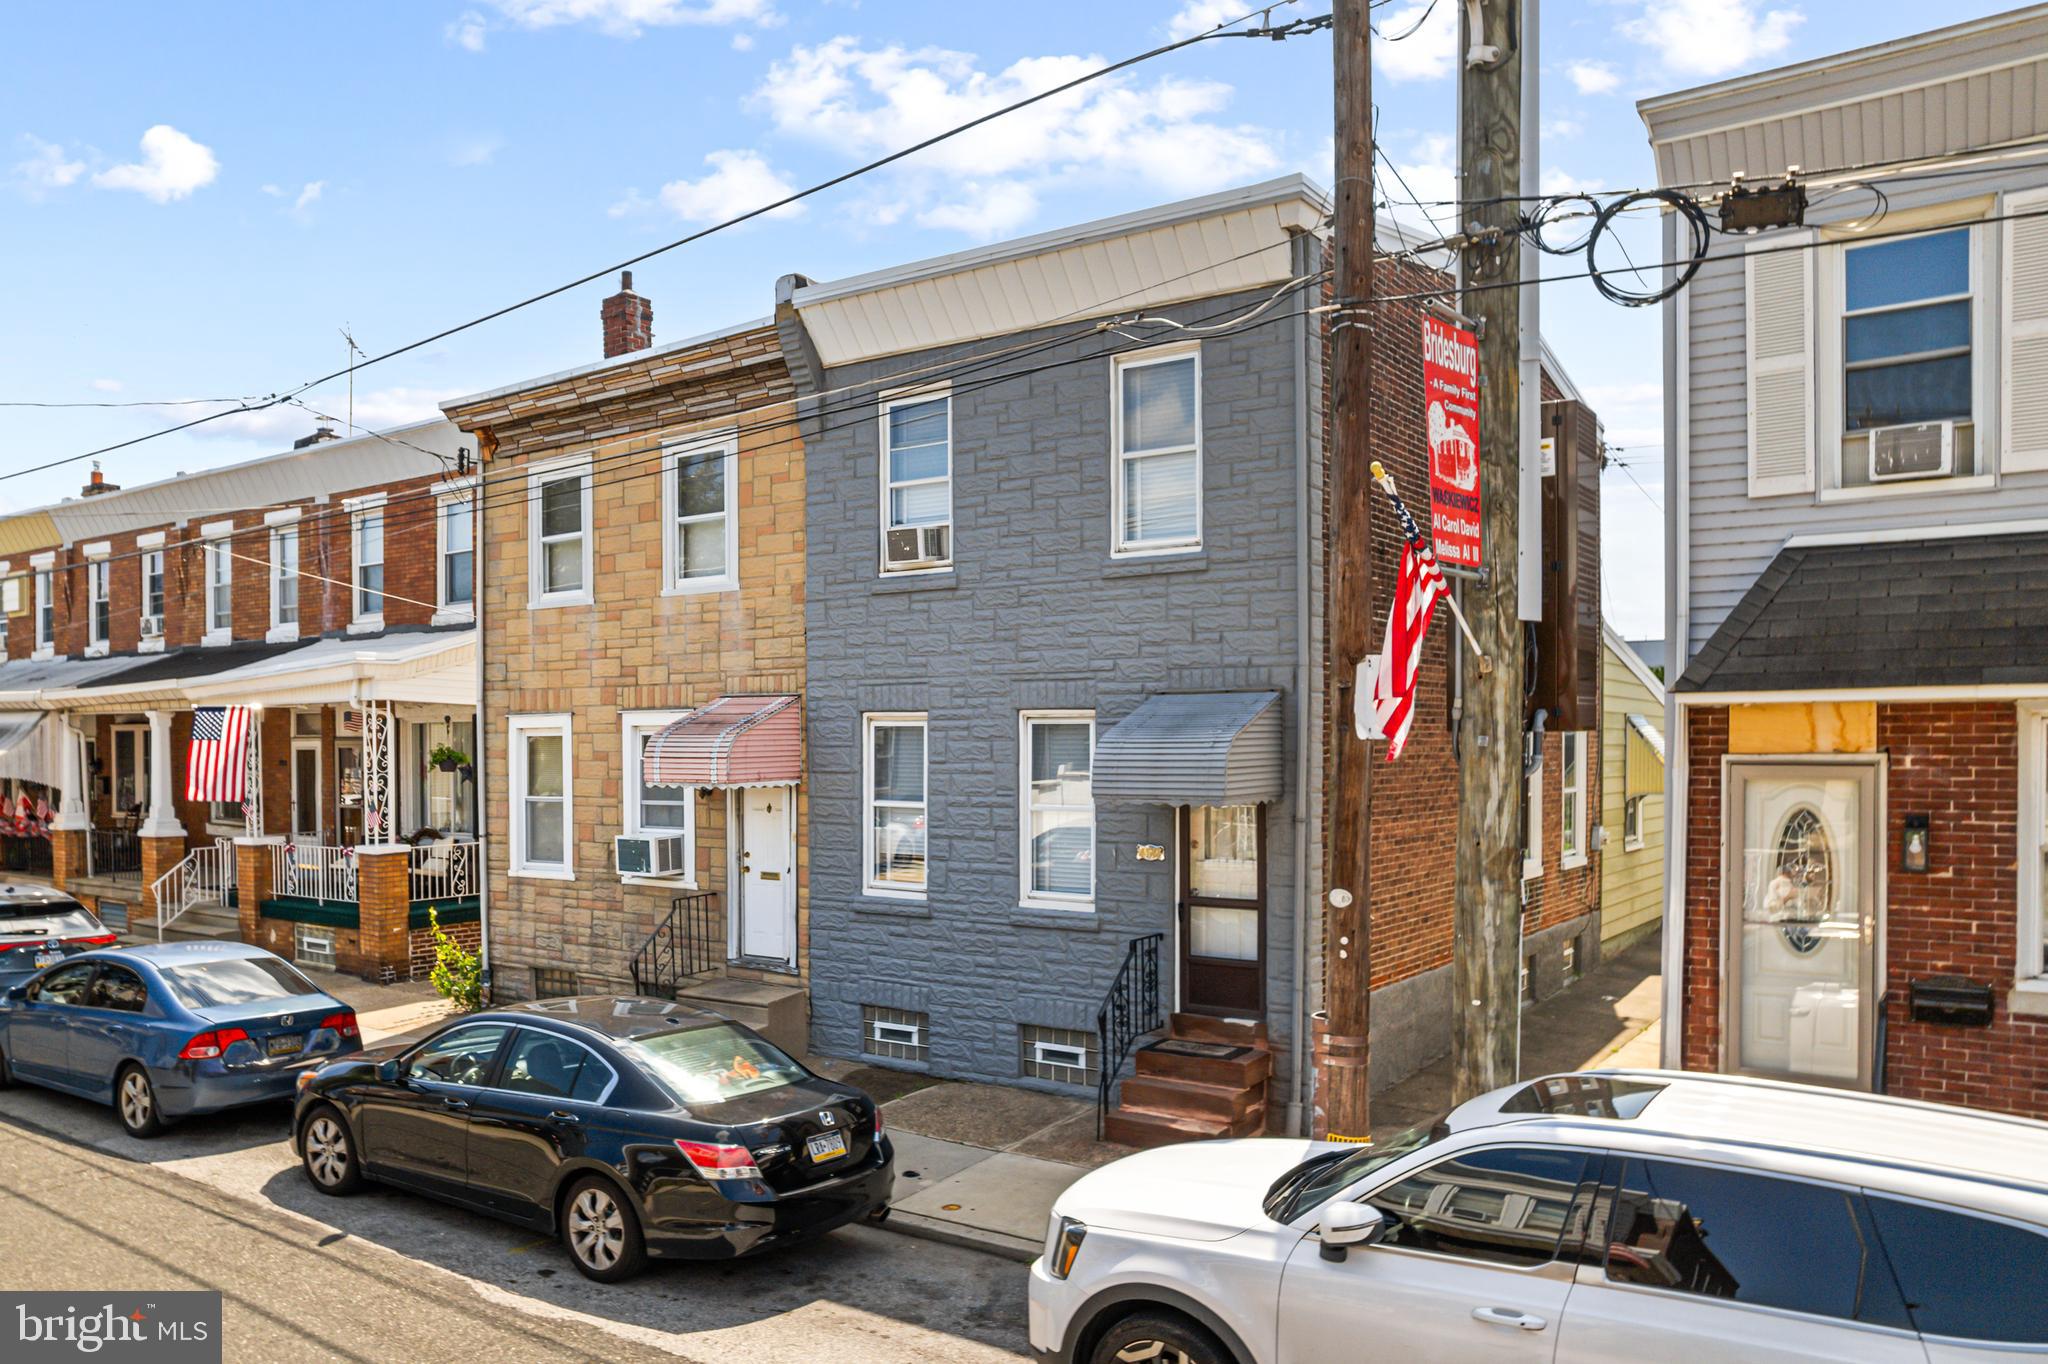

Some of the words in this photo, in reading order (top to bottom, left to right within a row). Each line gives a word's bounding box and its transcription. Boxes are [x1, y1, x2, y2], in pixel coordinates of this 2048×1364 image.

[1424, 320, 1477, 388] Bridesburg
[1439, 380, 1461, 398] Family
[1461, 386, 1476, 402] First
[1444, 399, 1477, 421] Community
[1432, 487, 1479, 513] WASKIEWICZ
[1441, 514, 1460, 534] Carol
[1460, 518, 1480, 538] David
[1435, 538, 1461, 559] Melissa
